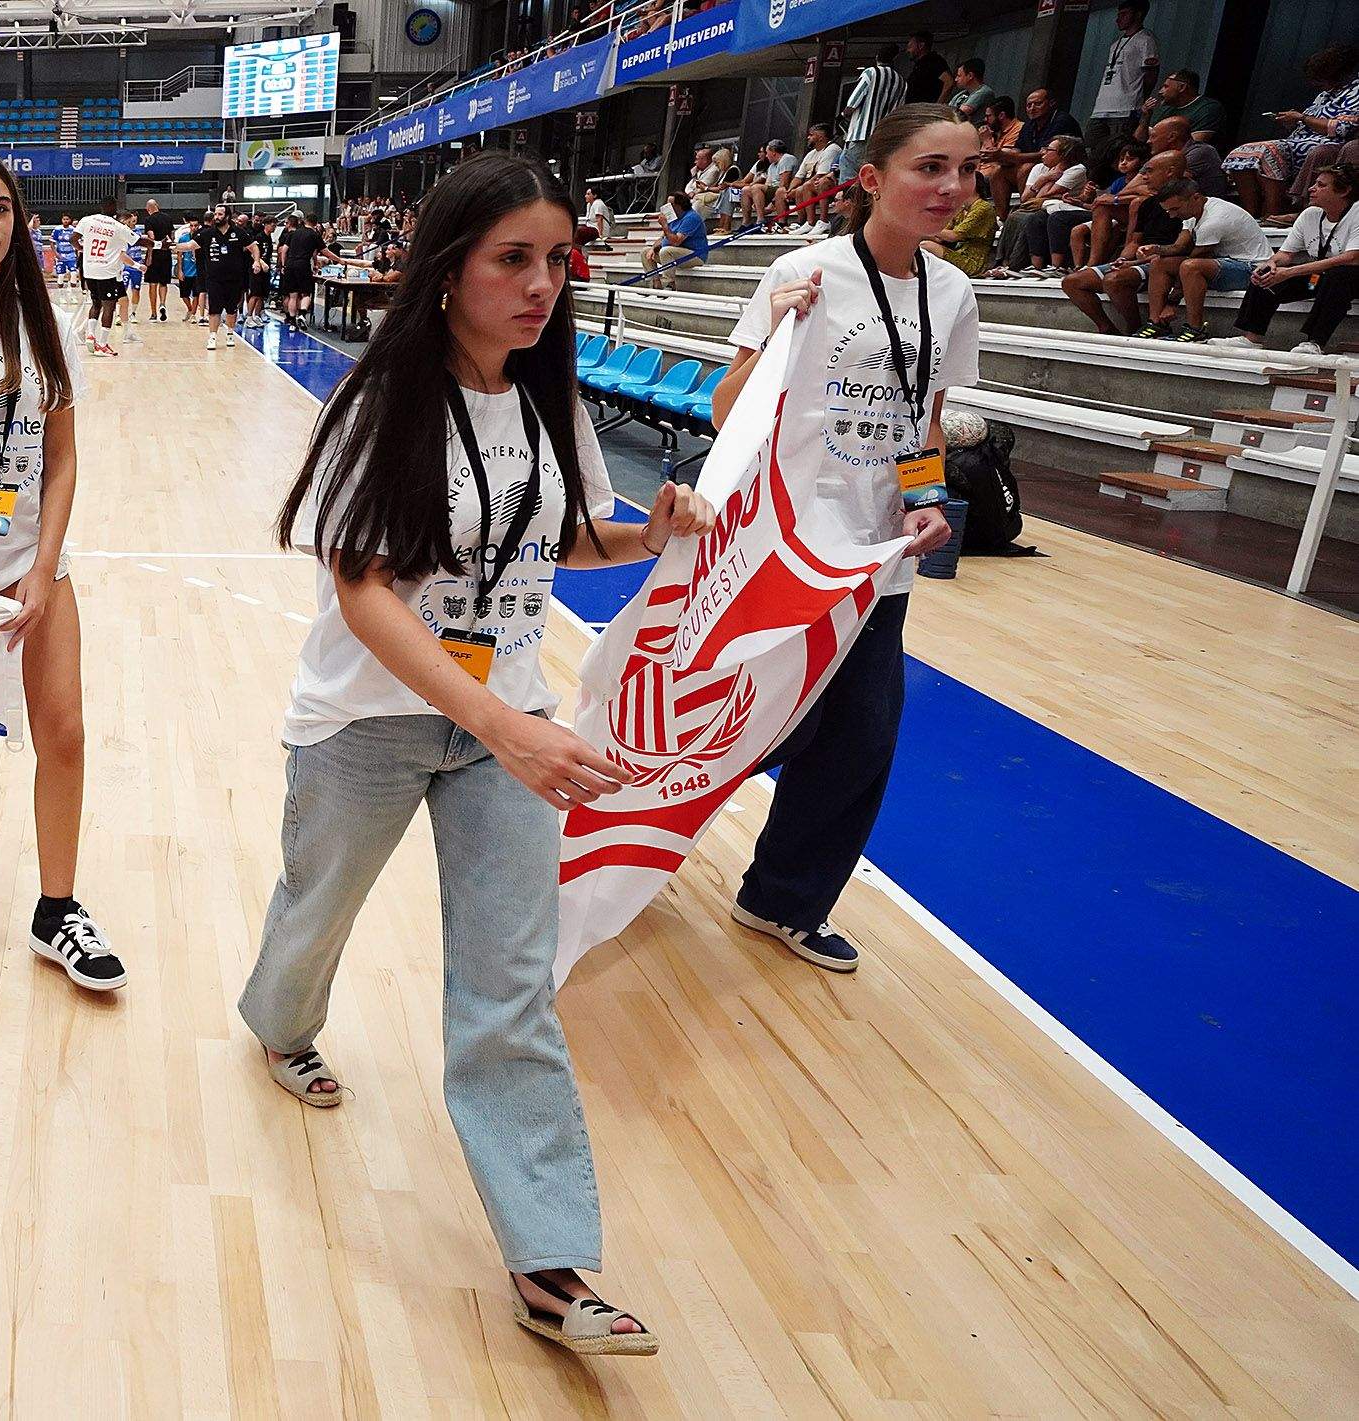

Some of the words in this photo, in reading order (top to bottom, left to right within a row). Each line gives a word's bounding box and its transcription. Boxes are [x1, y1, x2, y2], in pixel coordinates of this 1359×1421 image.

[622, 46, 661, 70] DEPORTE
[663, 19, 735, 55] PONTEVEDRA
[826, 47, 839, 60] A
[806, 63, 813, 76] A
[388, 118, 425, 152] Pontevedra
[350, 136, 377, 162] Pontevedra
[90, 238, 108, 257] 22
[827, 322, 866, 370] TORNEO
[826, 377, 919, 406] nterpont
[902, 466, 927, 476] STAFF
[447, 466, 471, 537] RNEO
[498, 577, 528, 588] CIÓN
[663, 548, 748, 669] UCUREȘTI
[480, 626, 506, 634] 2025
[657, 772, 711, 800] 1948
